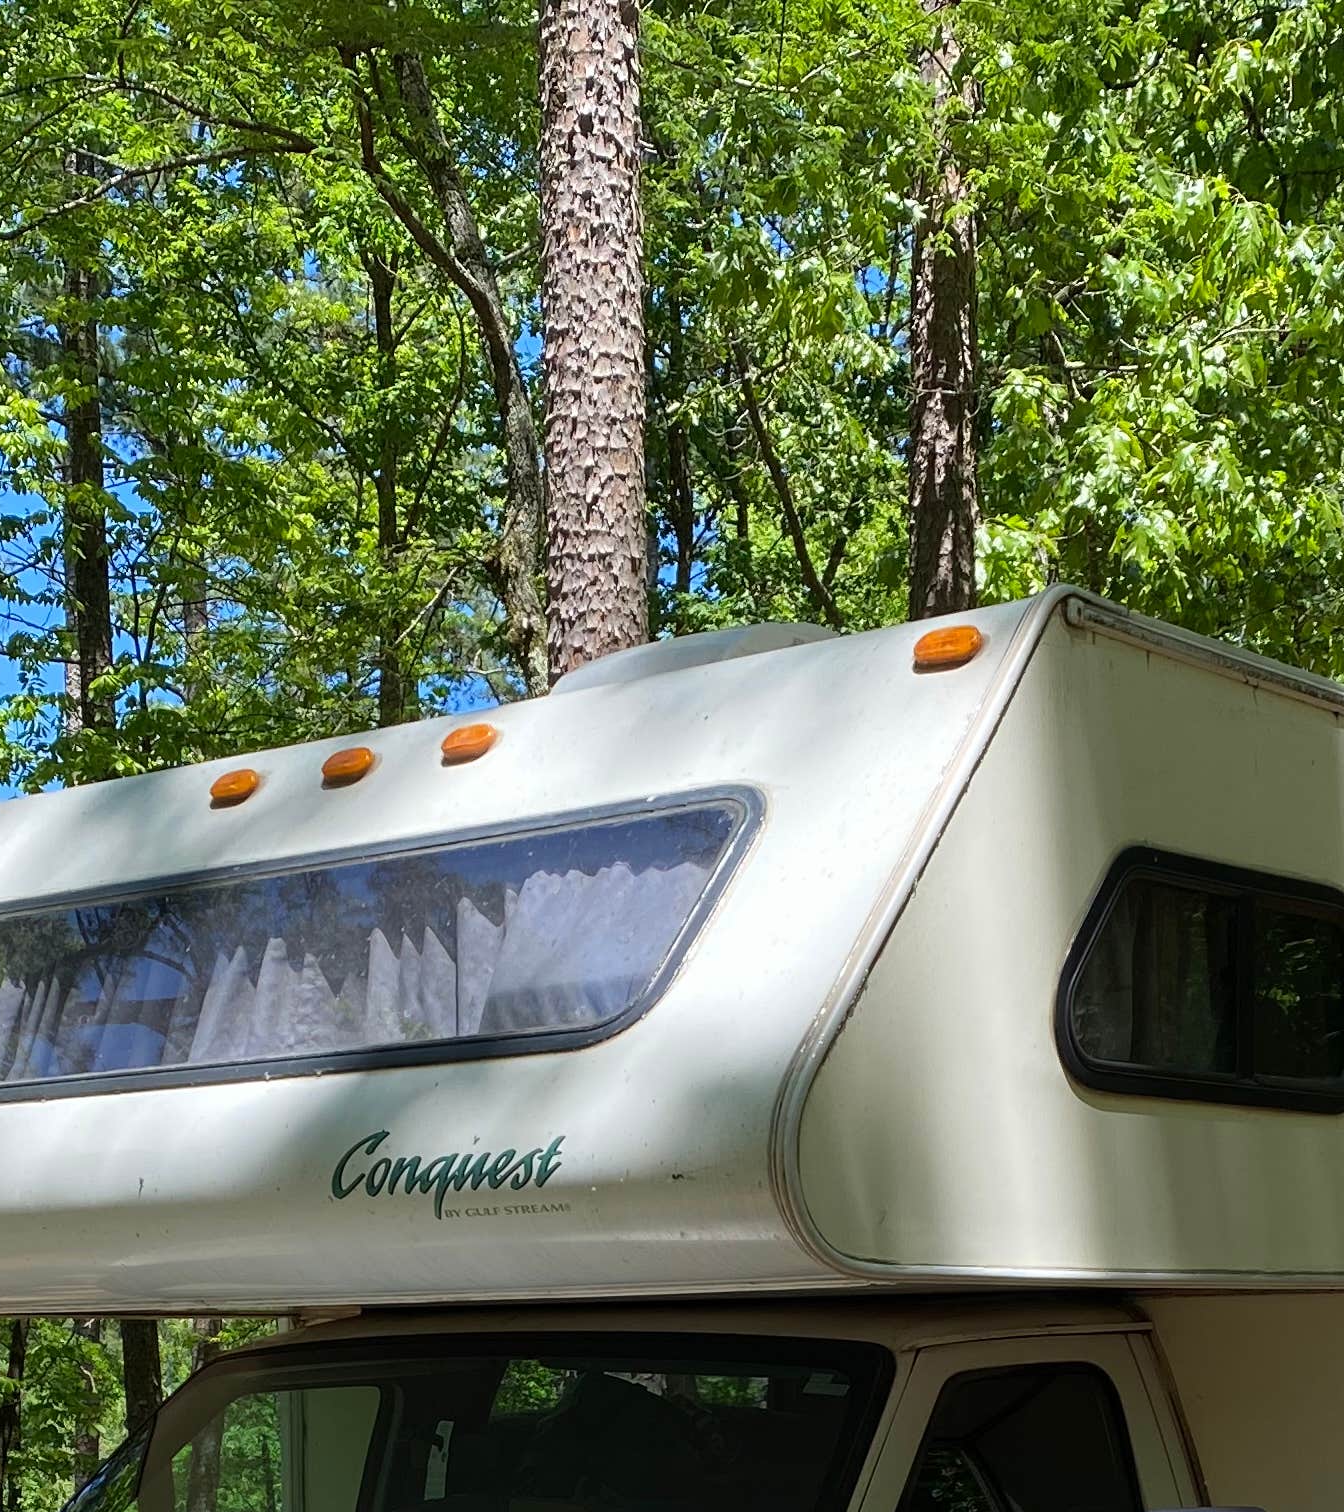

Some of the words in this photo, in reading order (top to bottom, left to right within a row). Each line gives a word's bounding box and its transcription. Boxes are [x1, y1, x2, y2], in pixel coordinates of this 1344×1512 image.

[331, 1129, 567, 1220] Conquest
[444, 1208, 461, 1218] BY
[465, 1206, 500, 1217] GULF
